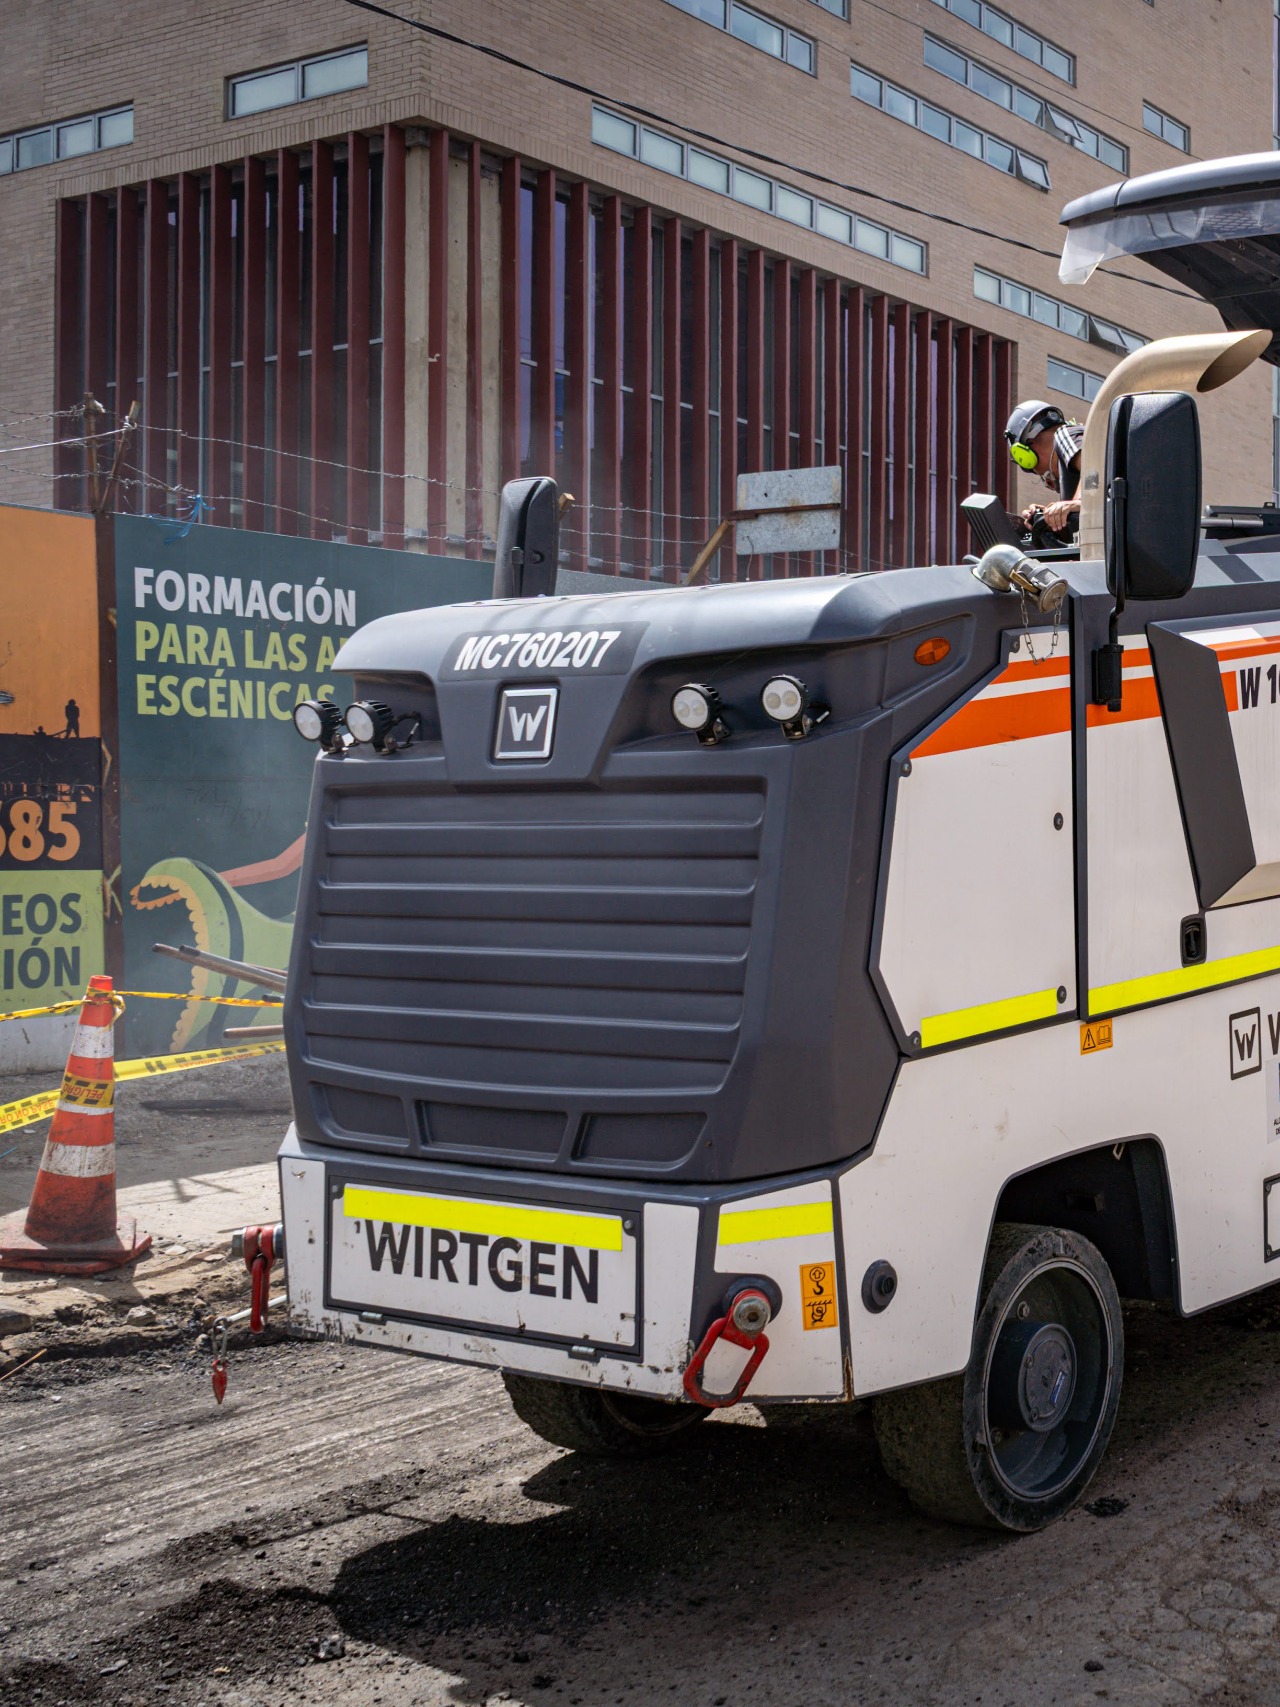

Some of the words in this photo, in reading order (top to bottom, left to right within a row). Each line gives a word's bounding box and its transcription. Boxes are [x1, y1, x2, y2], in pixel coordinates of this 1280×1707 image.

[134, 567, 357, 627] FORMACIÓN
[136, 620, 234, 668] PARA
[244, 629, 308, 672] LAS
[315, 636, 350, 673] A
[453, 630, 622, 672] MC760207
[1240, 666, 1261, 709] W
[0, 799, 81, 862] 85
[2, 892, 82, 936] EOS
[3, 936, 81, 990] IÓN
[63, 1082, 105, 1100] PELIGRO
[364, 1219, 600, 1305] WIRTGEN
